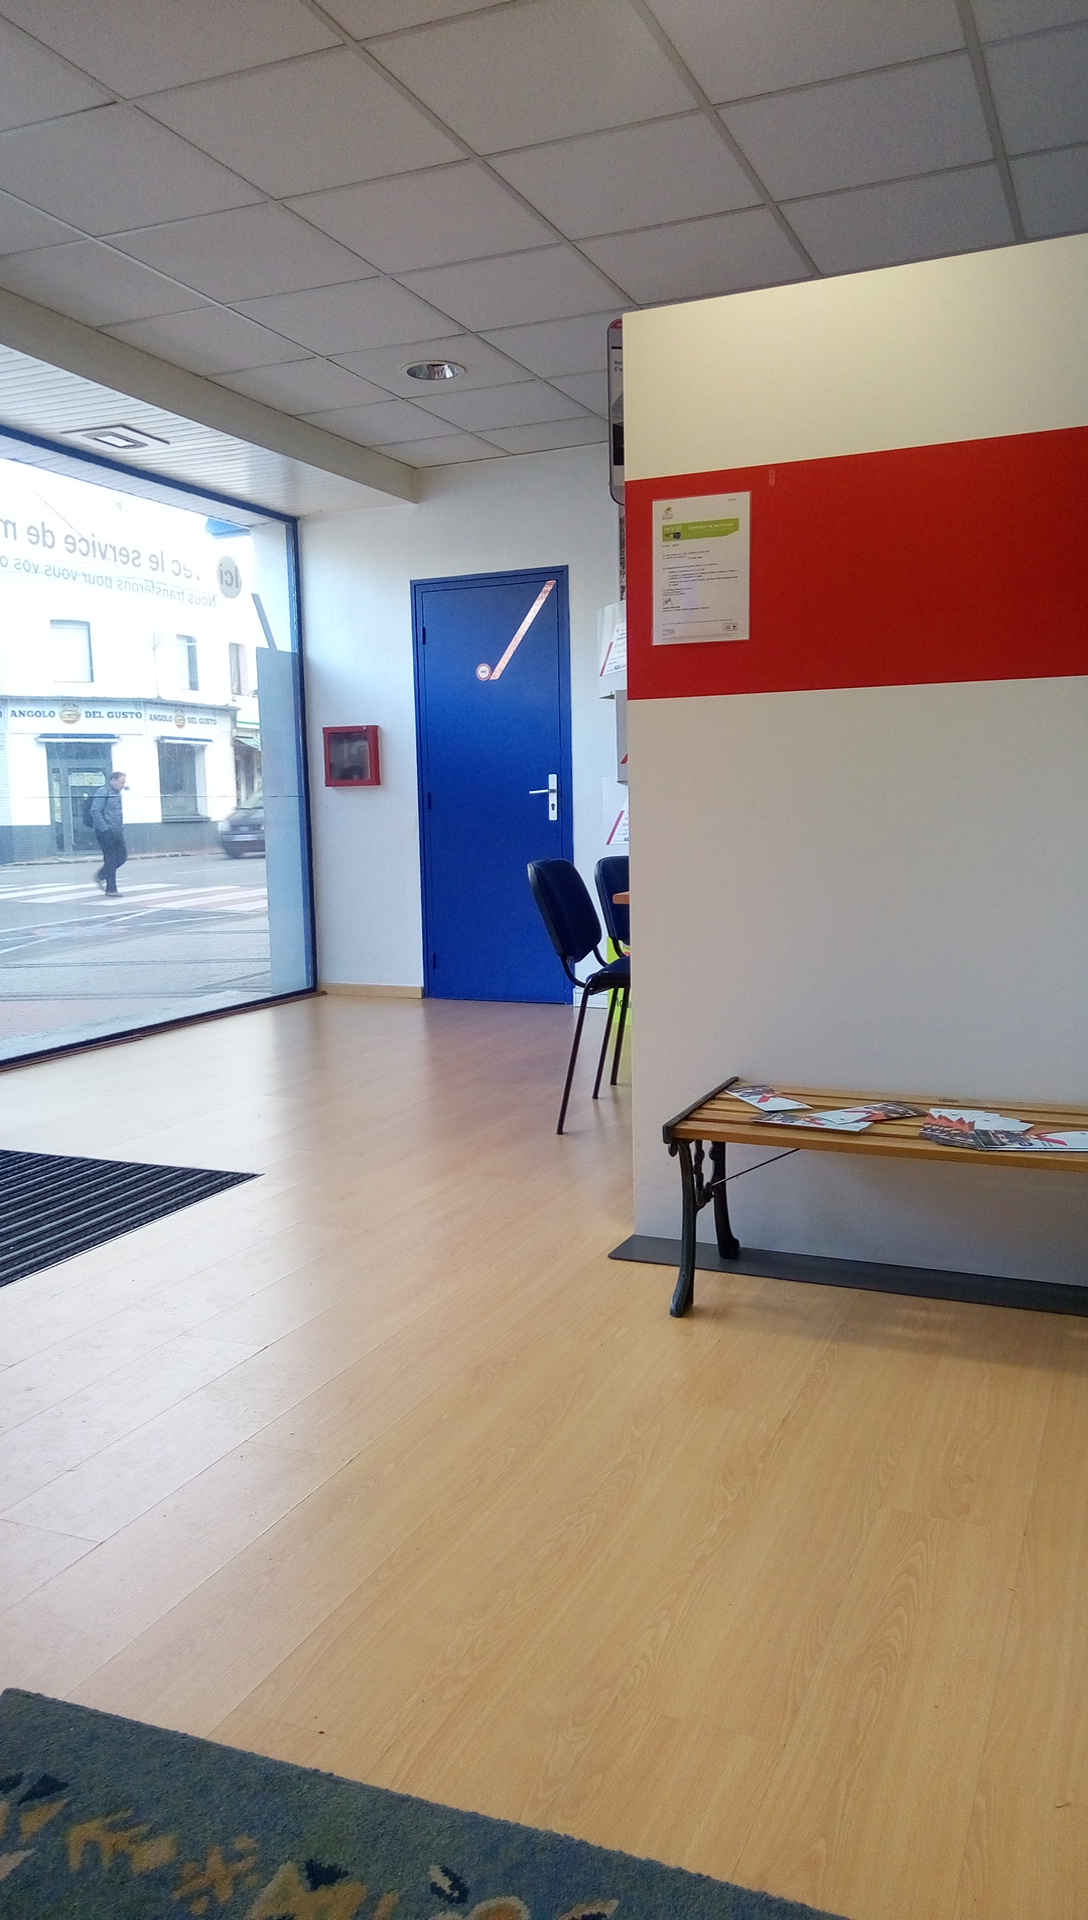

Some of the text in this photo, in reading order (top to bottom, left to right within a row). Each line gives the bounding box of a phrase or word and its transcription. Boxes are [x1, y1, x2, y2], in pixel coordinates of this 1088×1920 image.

[10, 710, 56, 718] ANGOLO
[85, 711, 104, 719] DEL
[107, 711, 143, 719] GUSTO
[149, 713, 217, 726] ANGOLO DEL GUSTO
